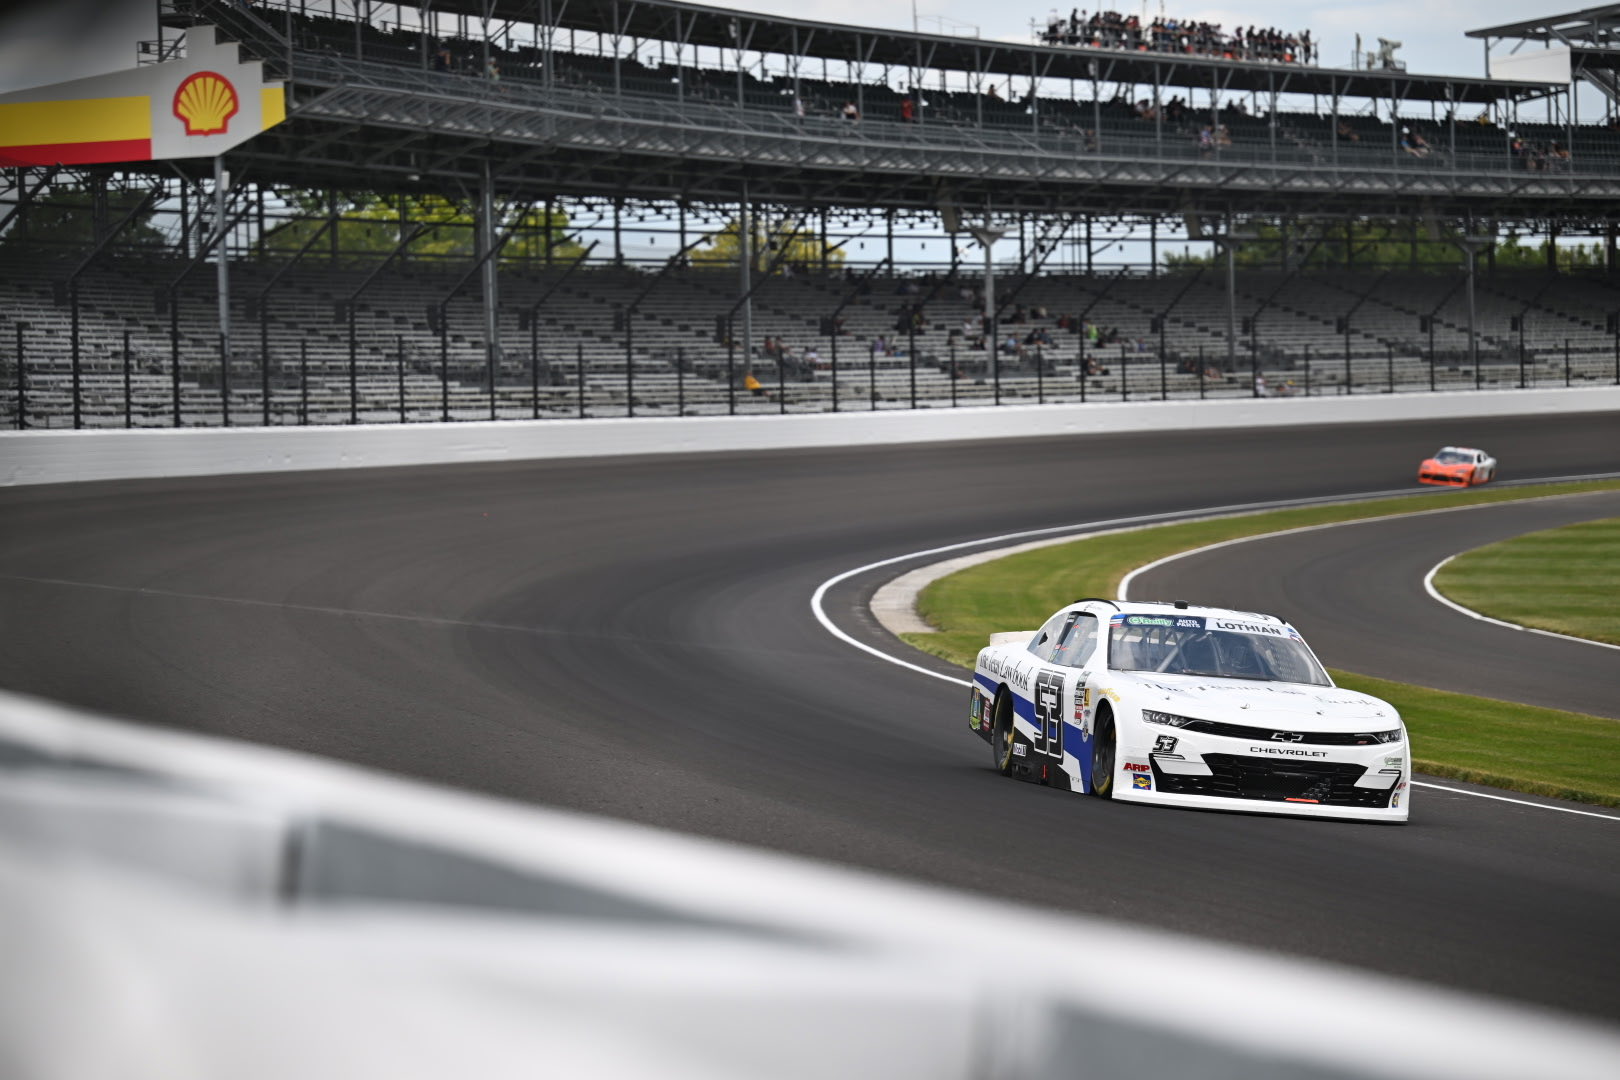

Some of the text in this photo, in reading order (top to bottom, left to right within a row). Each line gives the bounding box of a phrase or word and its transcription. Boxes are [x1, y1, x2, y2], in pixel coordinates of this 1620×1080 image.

[1216, 621, 1282, 635] LOTHIAN
[1033, 667, 1066, 765] 53
[1152, 734, 1179, 753] 53
[1250, 746, 1329, 758] CHEVROLET
[1123, 762, 1150, 773] ARP
